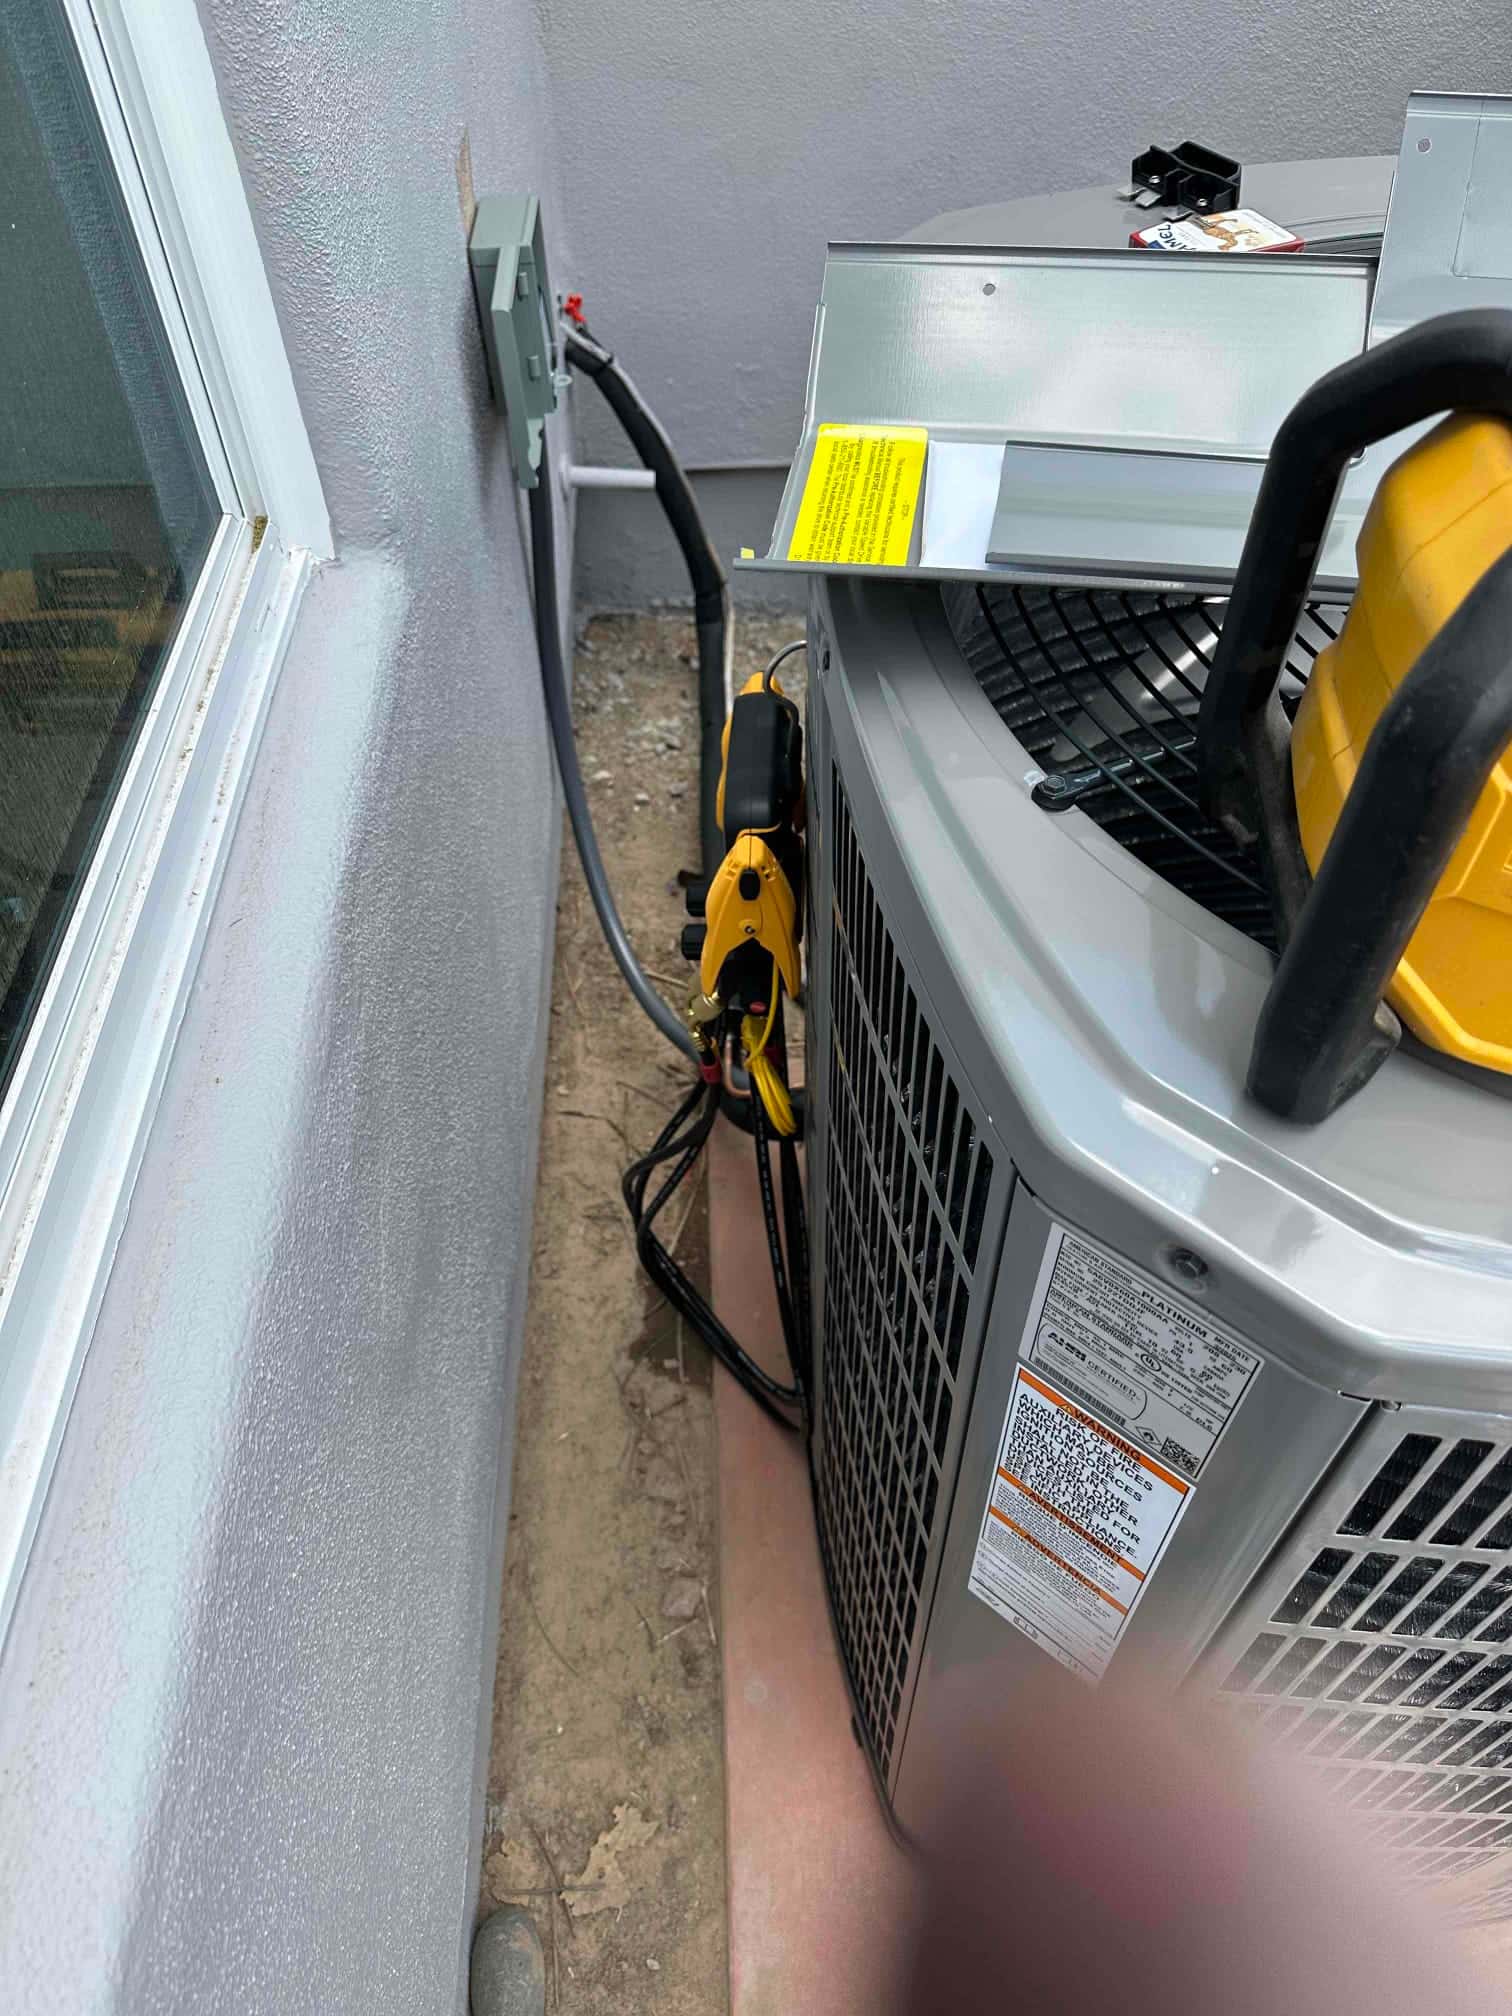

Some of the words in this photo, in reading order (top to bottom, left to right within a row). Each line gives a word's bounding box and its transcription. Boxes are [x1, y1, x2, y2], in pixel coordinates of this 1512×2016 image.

[1158, 224, 1196, 251] AMEL
[1140, 1289, 1208, 1338] PLATINUM
[1086, 1359, 1137, 1398] CERTIFIED
[1012, 1421, 1083, 1478] INSTALLED
[1085, 1474, 1100, 1490] IN
[1102, 1487, 1129, 1511] THE
[1014, 1414, 1057, 1450] SHALL
[1059, 1447, 1087, 1472] NOT
[1089, 1469, 1109, 1488] BE
[1016, 1406, 1074, 1453] IGNITION
[1075, 1449, 1143, 1503] SOURCES
[1017, 1398, 1062, 1436] WHICH
[1064, 1432, 1095, 1459] MAY
[1095, 1455, 1115, 1474] BE
[1019, 1390, 1091, 1448] AUXILIARY
[1092, 1443, 1154, 1492] DEVICES
[1055, 1406, 1087, 1435] RISK
[1089, 1431, 1108, 1449] OF
[1110, 1446, 1142, 1473] FIRE
[1073, 1407, 1142, 1463] WARNING
[1003, 1462, 1028, 1484] SEE
[1004, 1455, 1061, 1502] SPECIFIC
[1061, 1498, 1139, 1559] APPLIANCE.
[1006, 1449, 1032, 1473] USE
[1033, 1469, 1065, 1497] WITH
[1069, 1495, 1095, 1518] THE
[1007, 1442, 1062, 1487] DEVICES
[1064, 1484, 1110, 1522] LISTED
[1111, 1519, 1141, 1545] FOR
[1009, 1435, 1044, 1466] THAN
[1045, 1462, 1114, 1517] AUXILIARY
[1090, 1487, 1138, 1526] OTHER
[1017, 1491, 1057, 1524] RISQUE
[1058, 1521, 1118, 1568] D'INCENDIE
[1027, 1490, 1122, 1564] AVERTISSEMENT
[1023, 1532, 1102, 1595] ADVERTENCIA
[1049, 1560, 1063, 1573] DE
[1064, 1571, 1100, 1601] FUEGO
